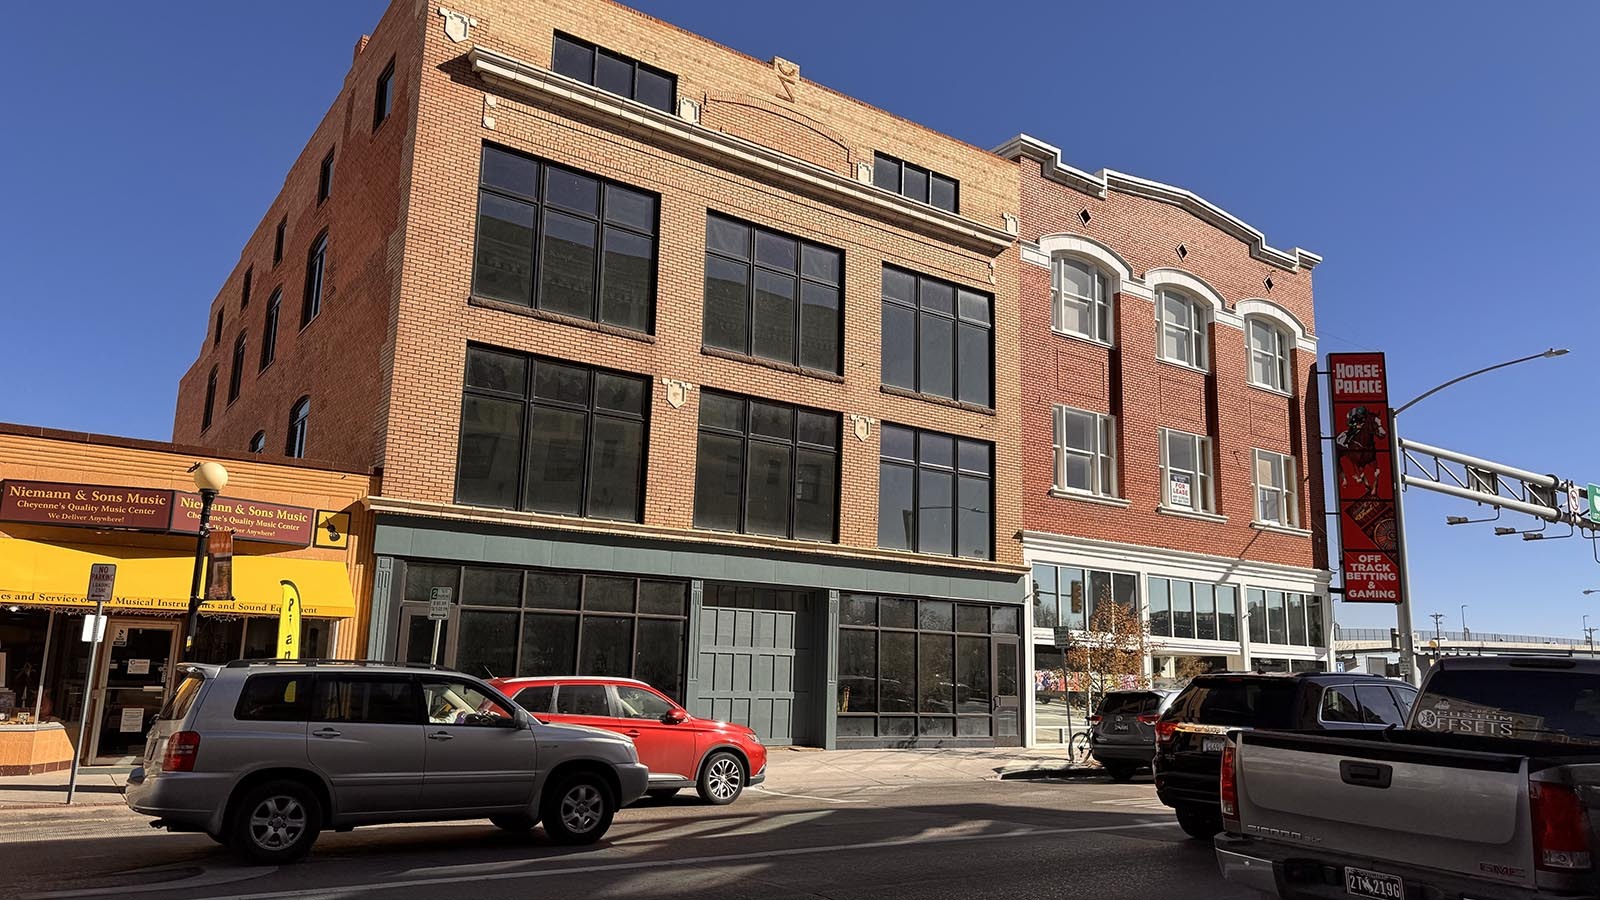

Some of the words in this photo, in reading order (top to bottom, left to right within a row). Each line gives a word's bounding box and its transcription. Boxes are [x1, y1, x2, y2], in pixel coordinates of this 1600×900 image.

[1335, 363, 1379, 378] HORSE
[1335, 378, 1382, 394] PALACE
[9, 486, 71, 500] Niemann
[75, 489, 87, 501] &
[91, 490, 123, 503] Sons
[126, 493, 167, 506] Music
[1173, 488, 1188, 496] LEASE
[16, 500, 66, 511] Cheyenne's
[68, 502, 100, 514] Quality
[101, 505, 126, 514] Music
[128, 506, 156, 515] Center
[180, 497, 232, 513] Nieann
[235, 504, 246, 515] &
[248, 506, 274, 519] Sons
[276, 509, 308, 522] Music
[48, 512, 60, 520] We
[62, 513, 87, 521] Deliver
[88, 515, 125, 523] Anywhere!
[187, 511, 228, 523] Chenne's
[229, 516, 255, 528] Quality
[256, 519, 277, 528] Music
[277, 521, 300, 531] Center
[246, 527, 276, 537] Anywhere!
[1358, 555, 1382, 563] OFF
[99, 566, 109, 574] NO
[1350, 563, 1391, 572] TRACK
[92, 573, 114, 582] PARKING
[1345, 572, 1396, 581] BETTING
[1367, 581, 1376, 589] &
[1348, 589, 1396, 599] GAMING
[15, 593, 35, 601] and
[39, 593, 78, 604] Service
[115, 597, 154, 606] Musical
[218, 602, 235, 610] and
[238, 603, 267, 611] Sound
